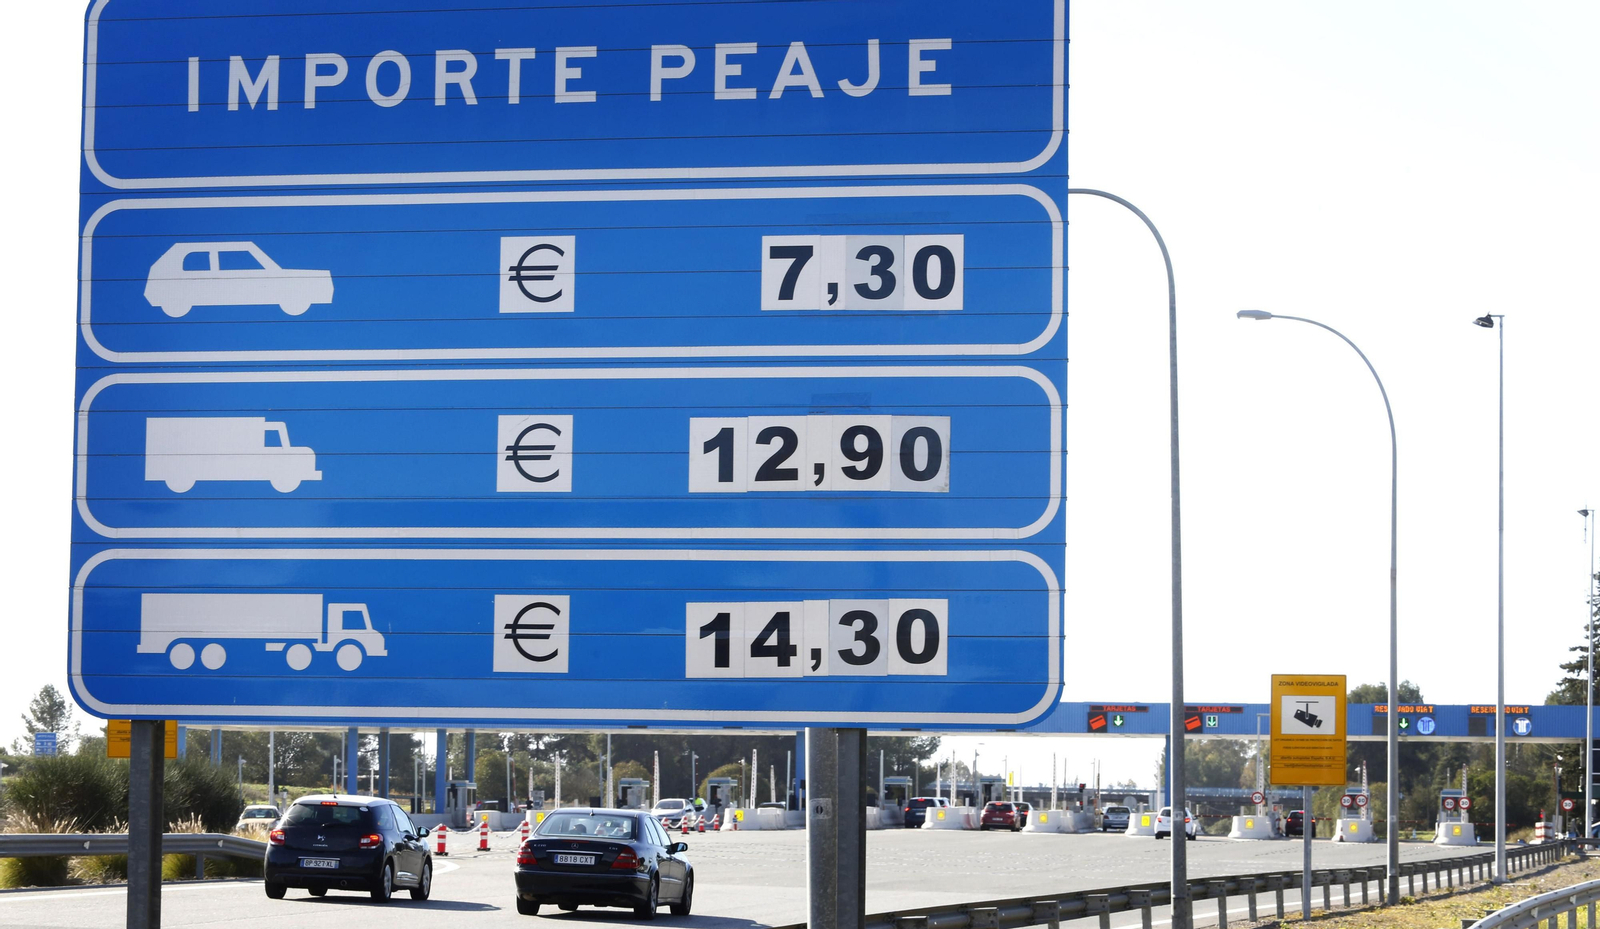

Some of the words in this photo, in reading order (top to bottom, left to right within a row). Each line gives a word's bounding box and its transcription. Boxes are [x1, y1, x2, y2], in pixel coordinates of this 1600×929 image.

[189, 47, 597, 111] IMPORTE
[651, 39, 952, 101] PEAJE
[508, 244, 565, 303] €
[770, 245, 956, 306] 7,30
[505, 423, 562, 483] €
[704, 426, 942, 487] 12,90
[503, 602, 561, 662] €
[700, 609, 940, 672] 14,30
[580, 856, 593, 864] CXT
